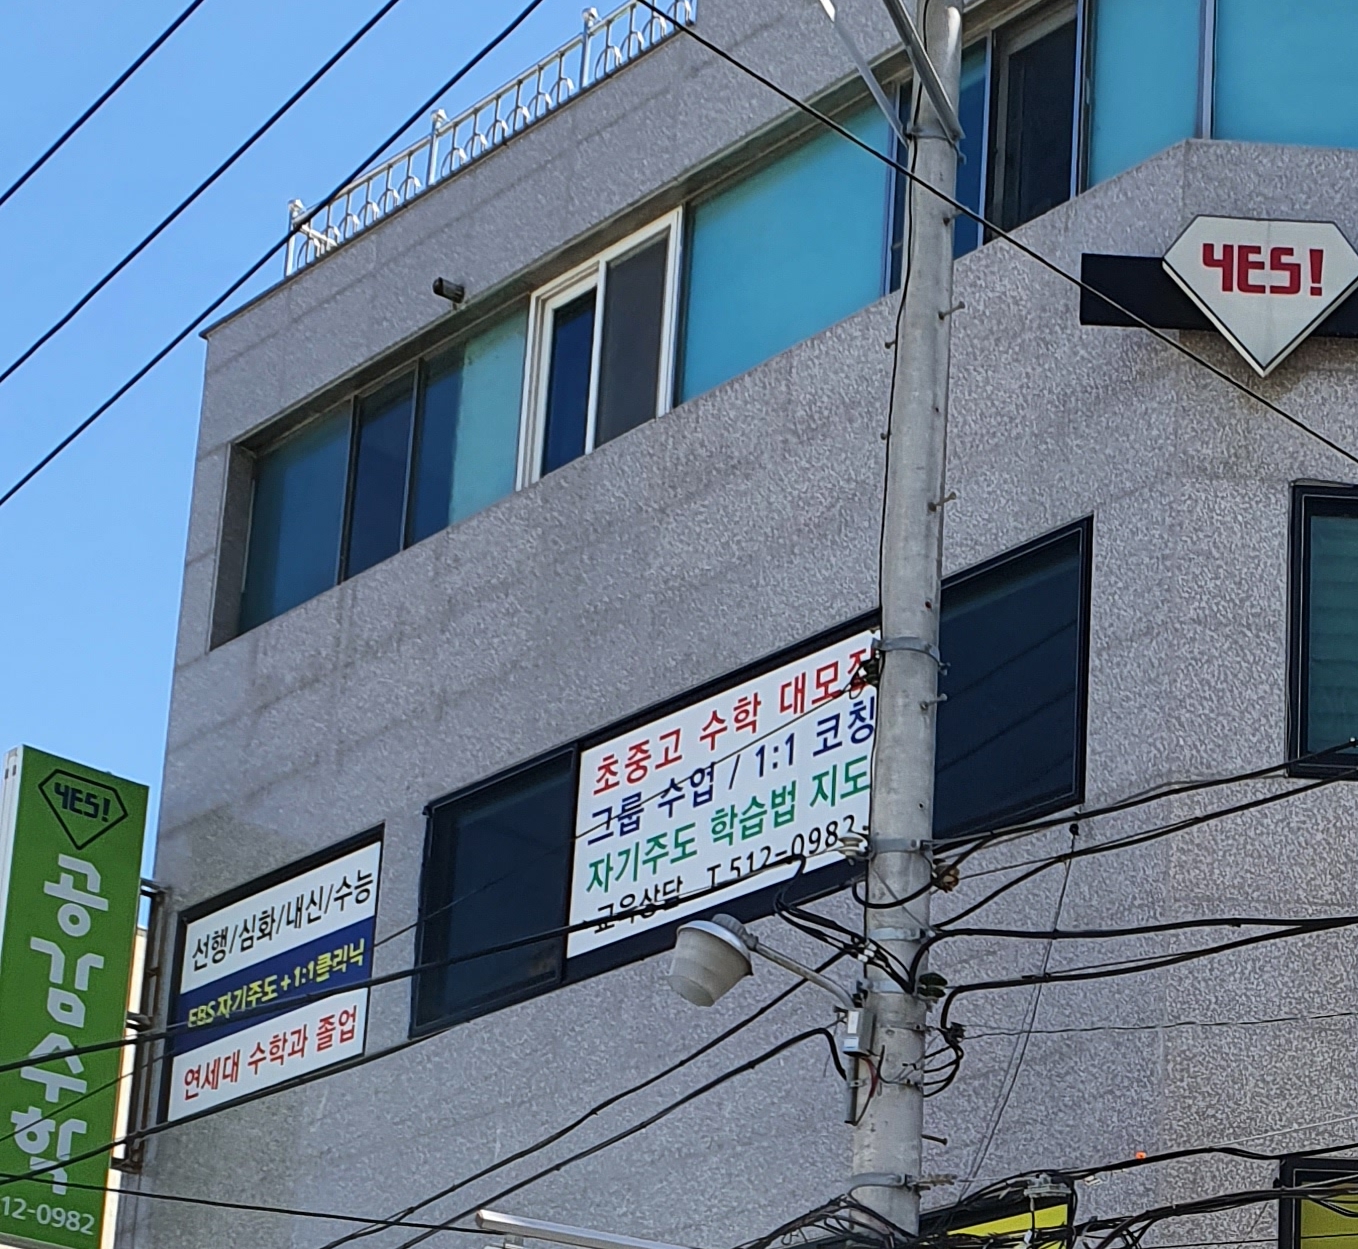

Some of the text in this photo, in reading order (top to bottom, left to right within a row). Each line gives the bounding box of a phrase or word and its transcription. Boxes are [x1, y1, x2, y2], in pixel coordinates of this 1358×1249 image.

[1202, 243, 1324, 297] YES!
[587, 791, 645, 846] 그룹
[657, 762, 716, 819] 수업
[755, 733, 796, 778] 1:1
[812, 696, 876, 758] 코칭
[593, 728, 683, 796] 초중고
[699, 692, 762, 752] 수학
[54, 782, 111, 823] YES!
[586, 755, 871, 893] 자기주도 학습법 지도
[192, 870, 374, 972] 선행/심화/내신/수능
[10, 853, 109, 1195] 공감수학
[184, 1005, 357, 1101] 연세대 수학과 졸업
